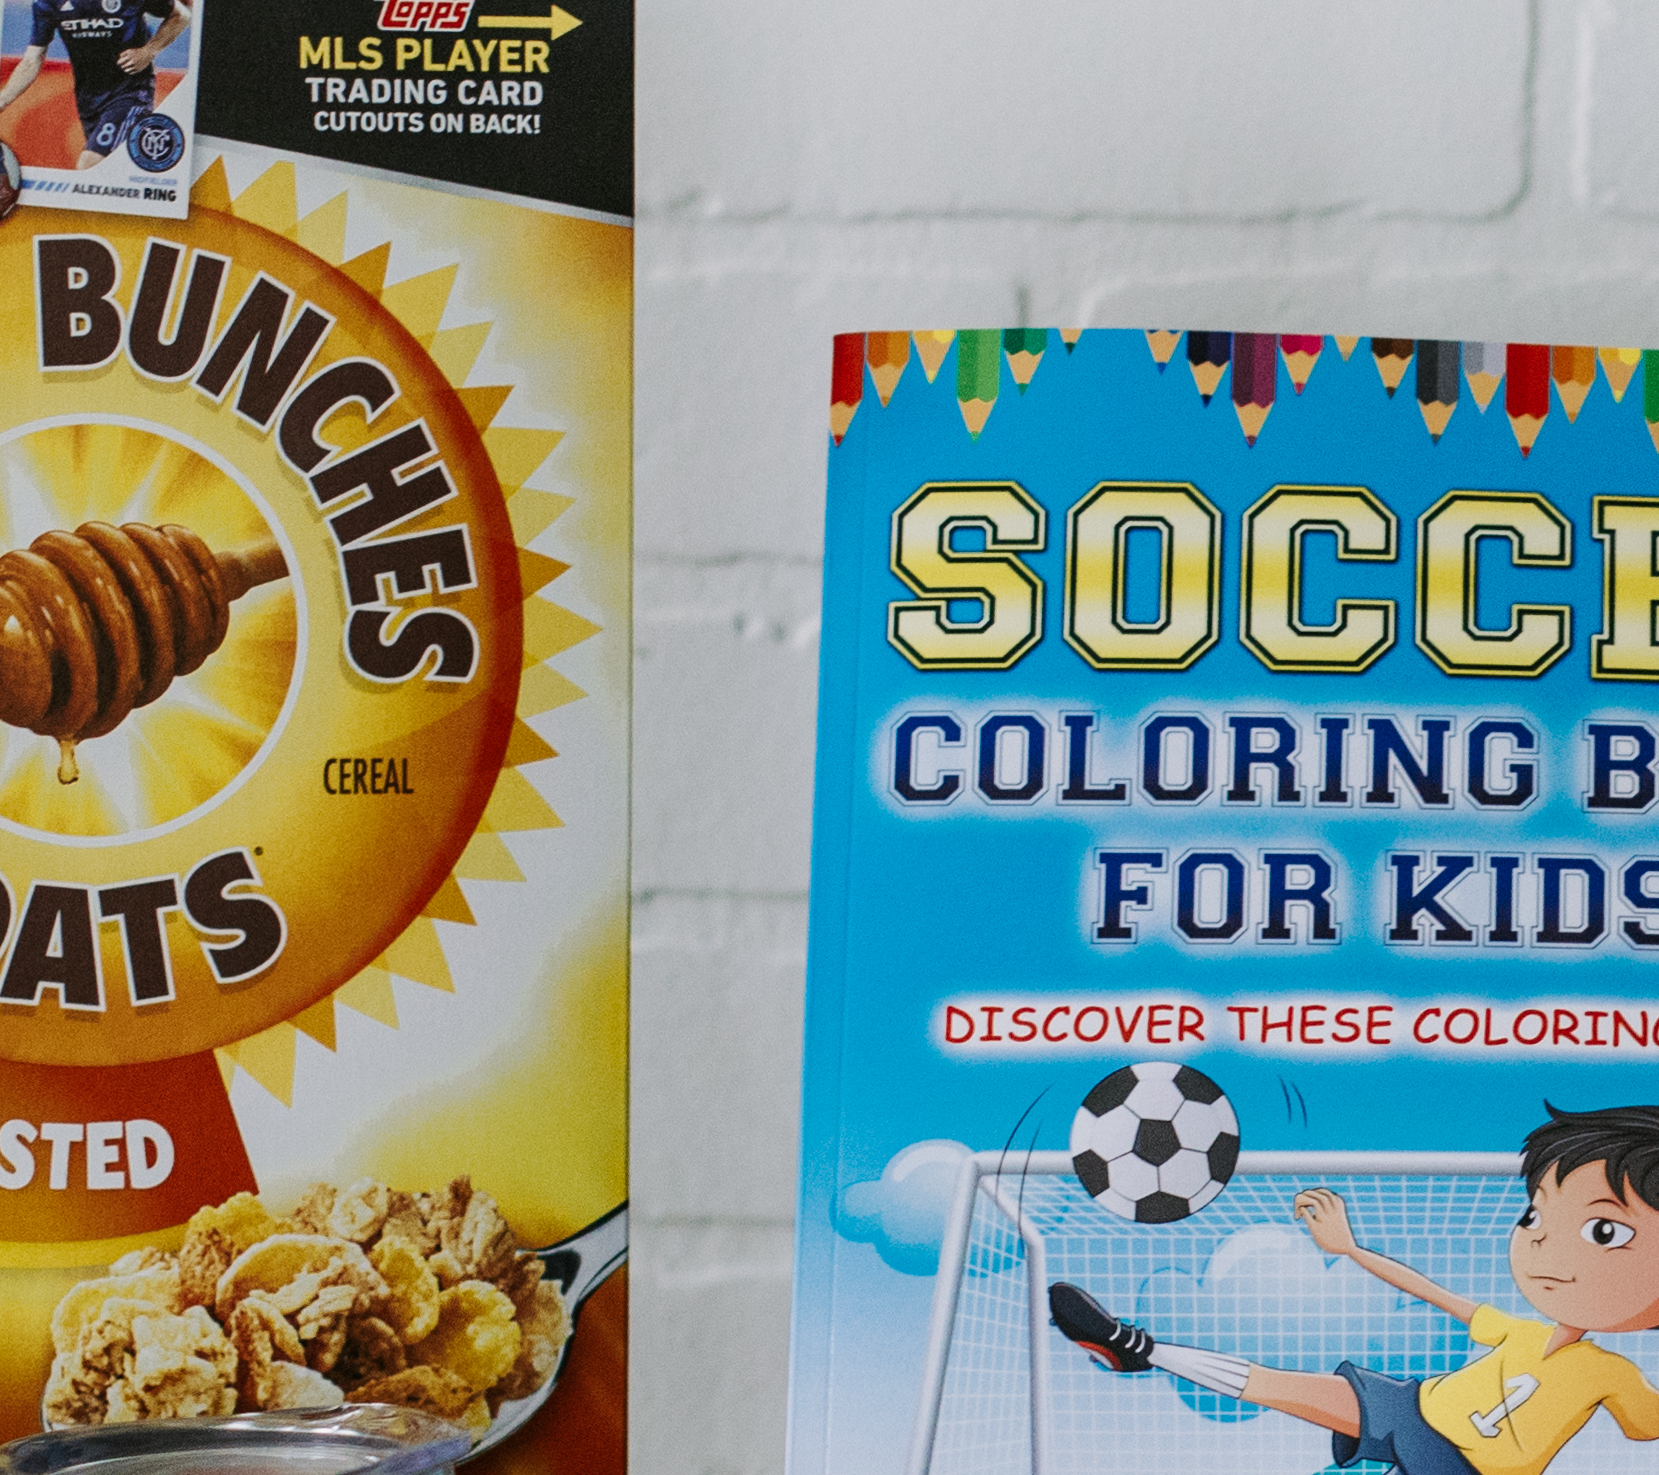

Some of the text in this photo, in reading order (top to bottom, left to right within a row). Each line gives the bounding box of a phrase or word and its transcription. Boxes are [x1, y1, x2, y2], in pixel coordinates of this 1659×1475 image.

[61, 17, 124, 31] ETIHAD
[299, 36, 550, 73] MLS PLAYER
[305, 77, 543, 106] TRADING CARD
[96, 122, 116, 146] 8
[313, 111, 541, 134] CUTOUTS ON BACK!
[72, 183, 176, 202] ALEXANDER RING
[31, 231, 480, 689] BUNCHES
[322, 757, 415, 796] CEREAL
[892, 713, 1542, 812] COLORING
[1092, 848, 1341, 946] FOR
[943, 1003, 1207, 1046] DISCOVER
[1227, 1005, 1394, 1044] THESE
[1468, 1373, 1539, 1438] 1
